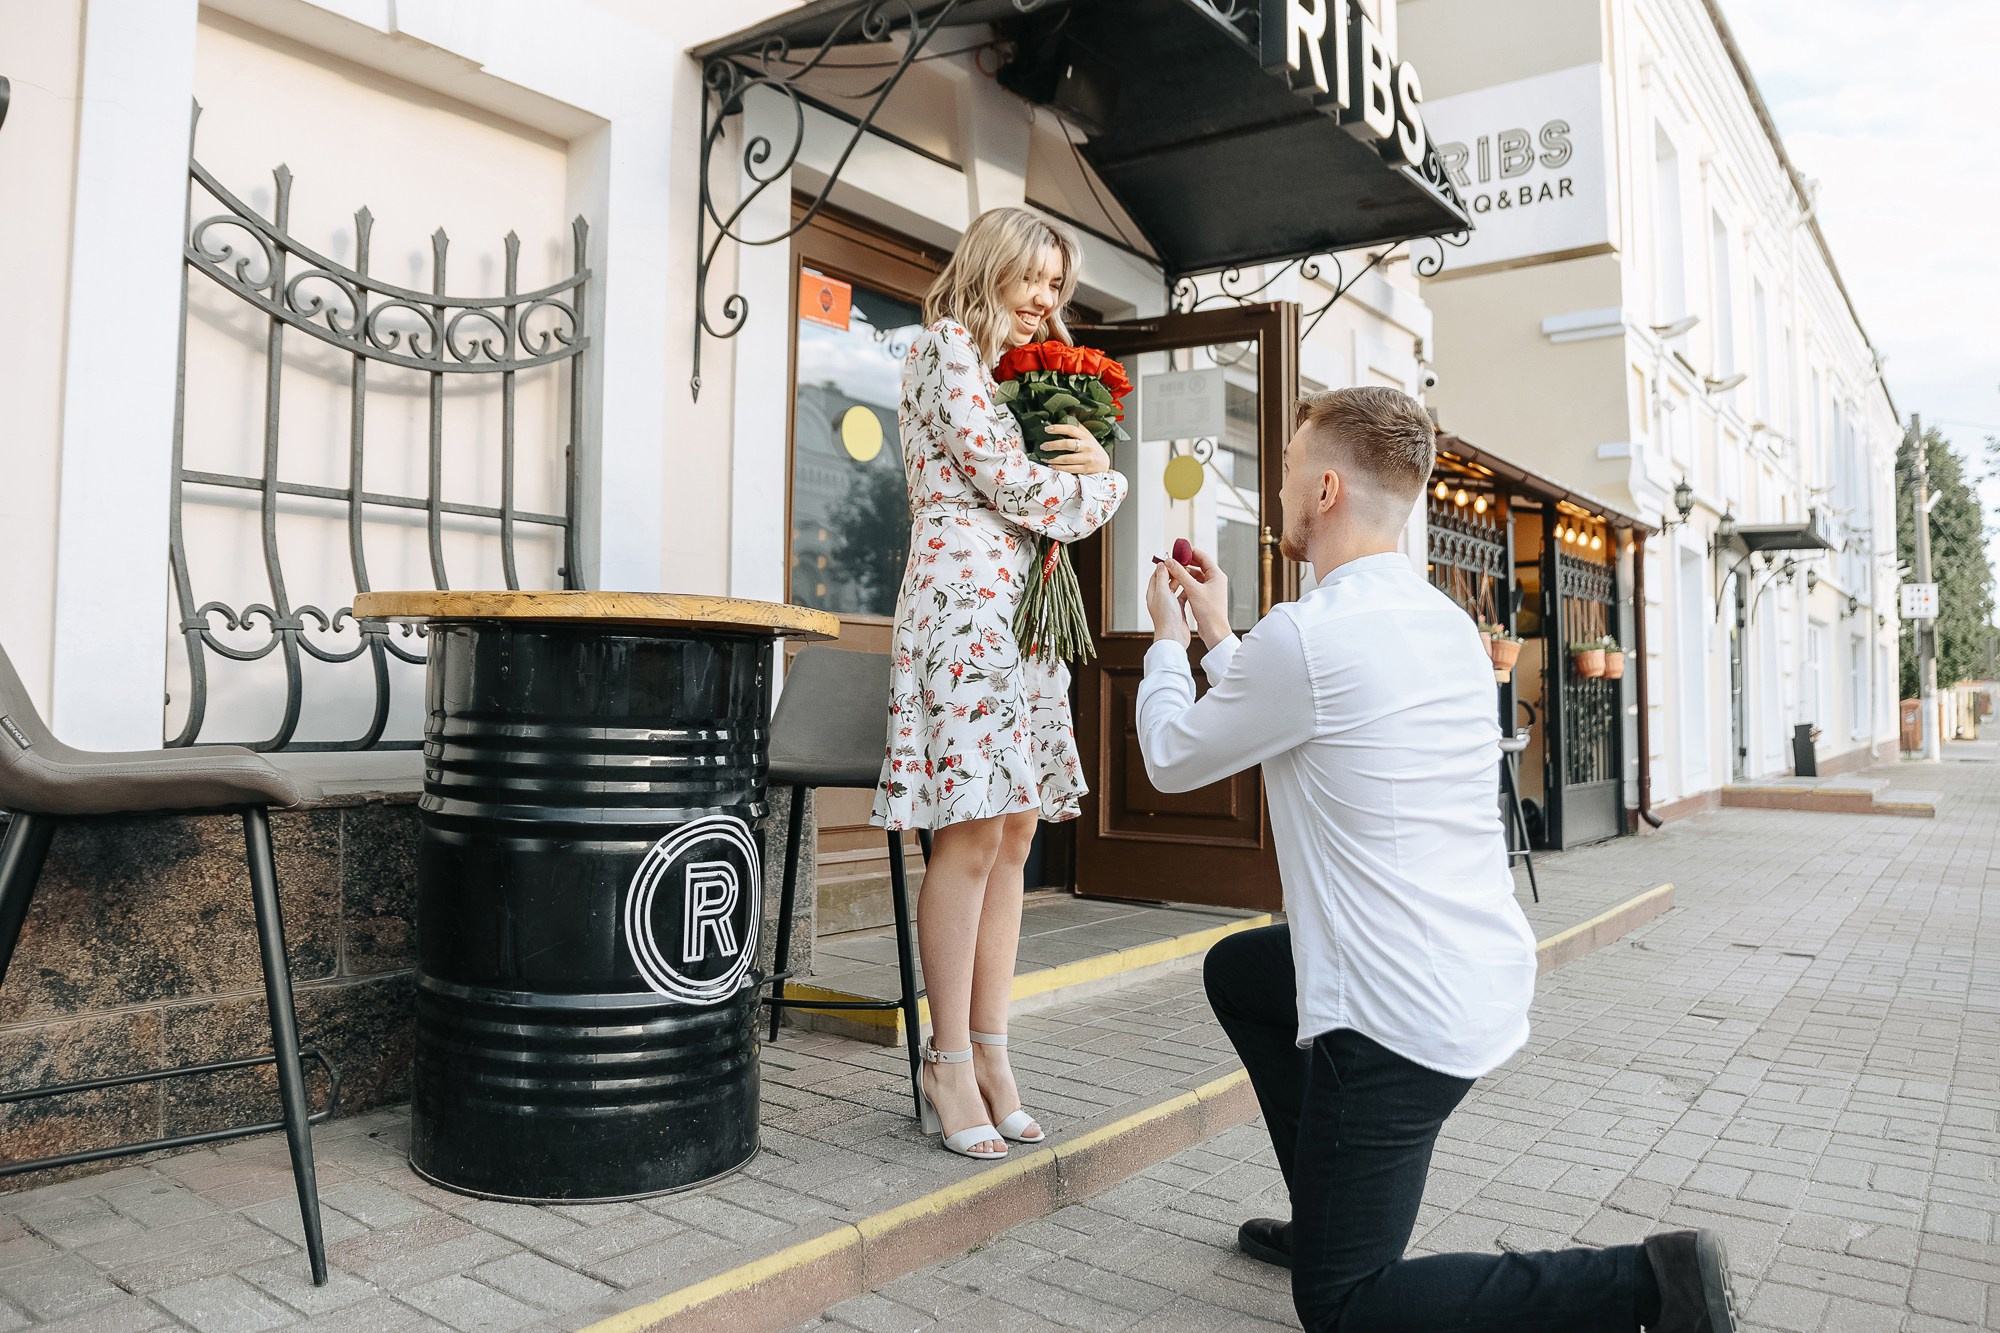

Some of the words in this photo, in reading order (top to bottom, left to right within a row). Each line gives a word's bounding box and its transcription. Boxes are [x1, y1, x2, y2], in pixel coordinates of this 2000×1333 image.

[1286, 0, 1426, 167] RIBS
[1436, 119, 1572, 187] RIBS
[1462, 177, 1575, 214] Q&BAR
[683, 861, 738, 962] R
